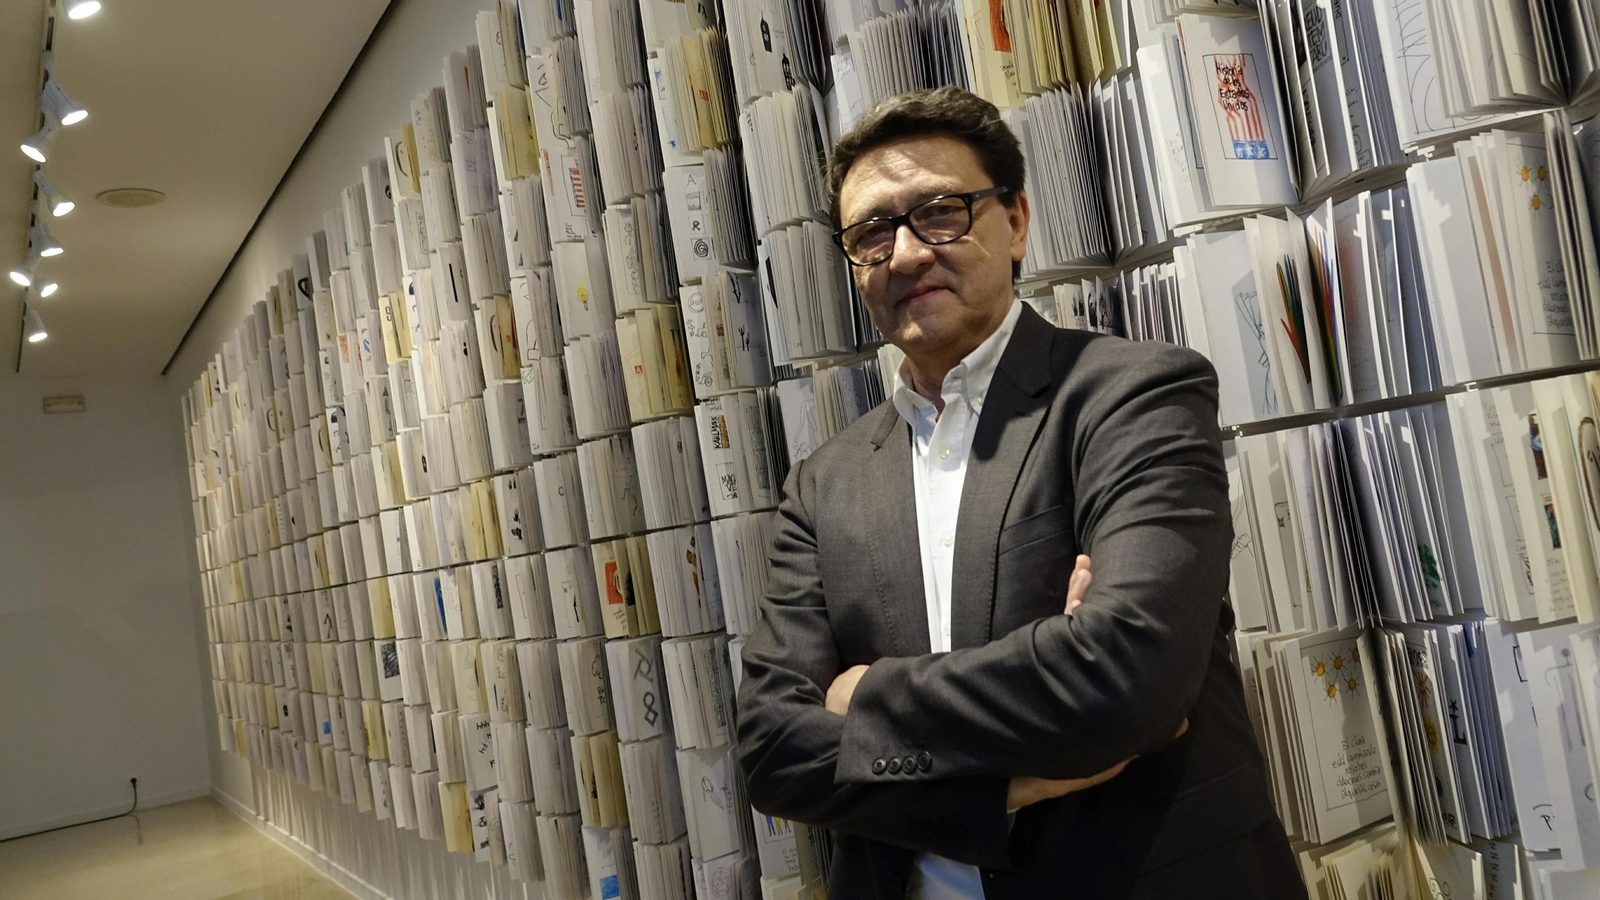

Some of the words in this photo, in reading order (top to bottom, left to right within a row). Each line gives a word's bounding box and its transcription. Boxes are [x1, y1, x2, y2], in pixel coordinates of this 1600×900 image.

[1216, 62, 1243, 77] Historia
[1219, 87, 1250, 99] Estados
[1223, 99, 1249, 111] Unidos
[1341, 736, 1350, 751] El
